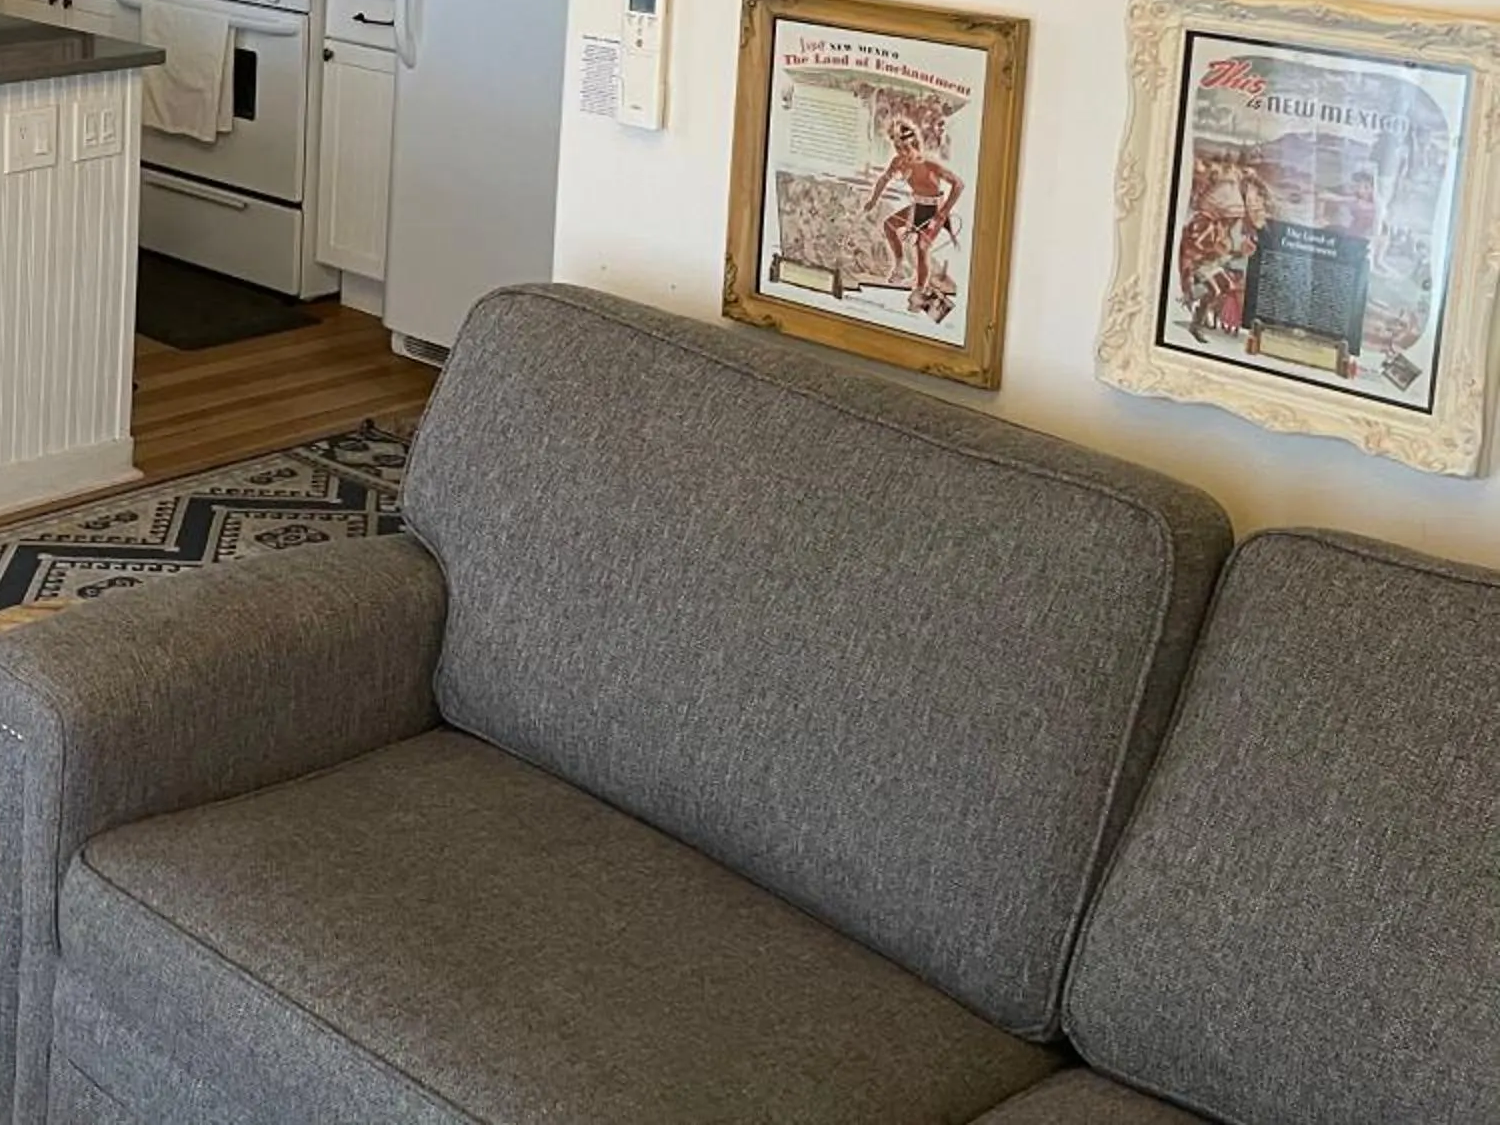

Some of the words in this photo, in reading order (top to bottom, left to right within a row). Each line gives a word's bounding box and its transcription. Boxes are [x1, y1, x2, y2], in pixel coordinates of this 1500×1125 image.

[784, 53, 809, 65] The
[813, 53, 849, 66] Land
[855, 56, 869, 67] of
[875, 58, 972, 97] Enchantment
[1199, 59, 1268, 95] This
[1267, 96, 1315, 118] NEW
